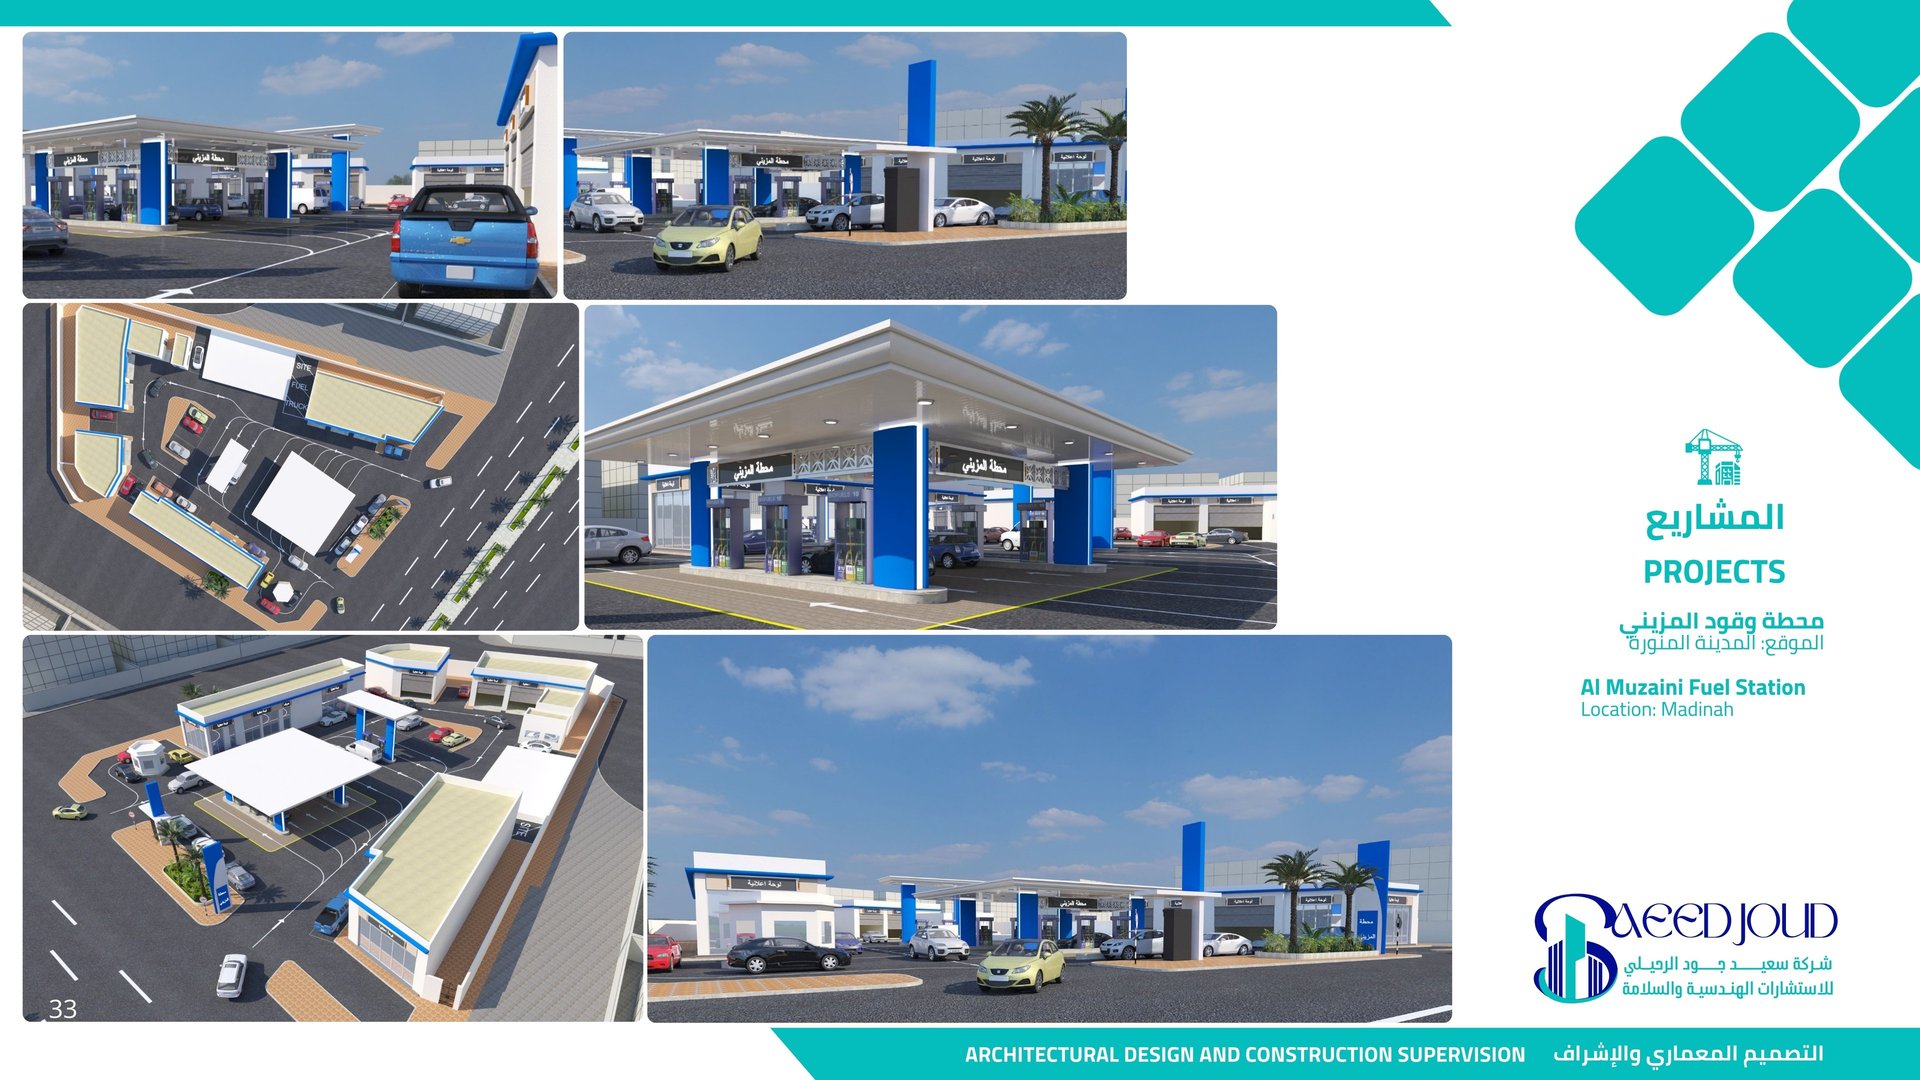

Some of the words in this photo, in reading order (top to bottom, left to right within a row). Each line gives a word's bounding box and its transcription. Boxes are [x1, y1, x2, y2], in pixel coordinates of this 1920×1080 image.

[296, 362, 312, 372] SITE
[291, 381, 309, 392] FUEL
[285, 399, 309, 410] TRUCK
[755, 461, 774, 474] محطة
[962, 457, 988, 474] المزيني
[988, 458, 1008, 474] محطة
[733, 463, 755, 482] المزيني
